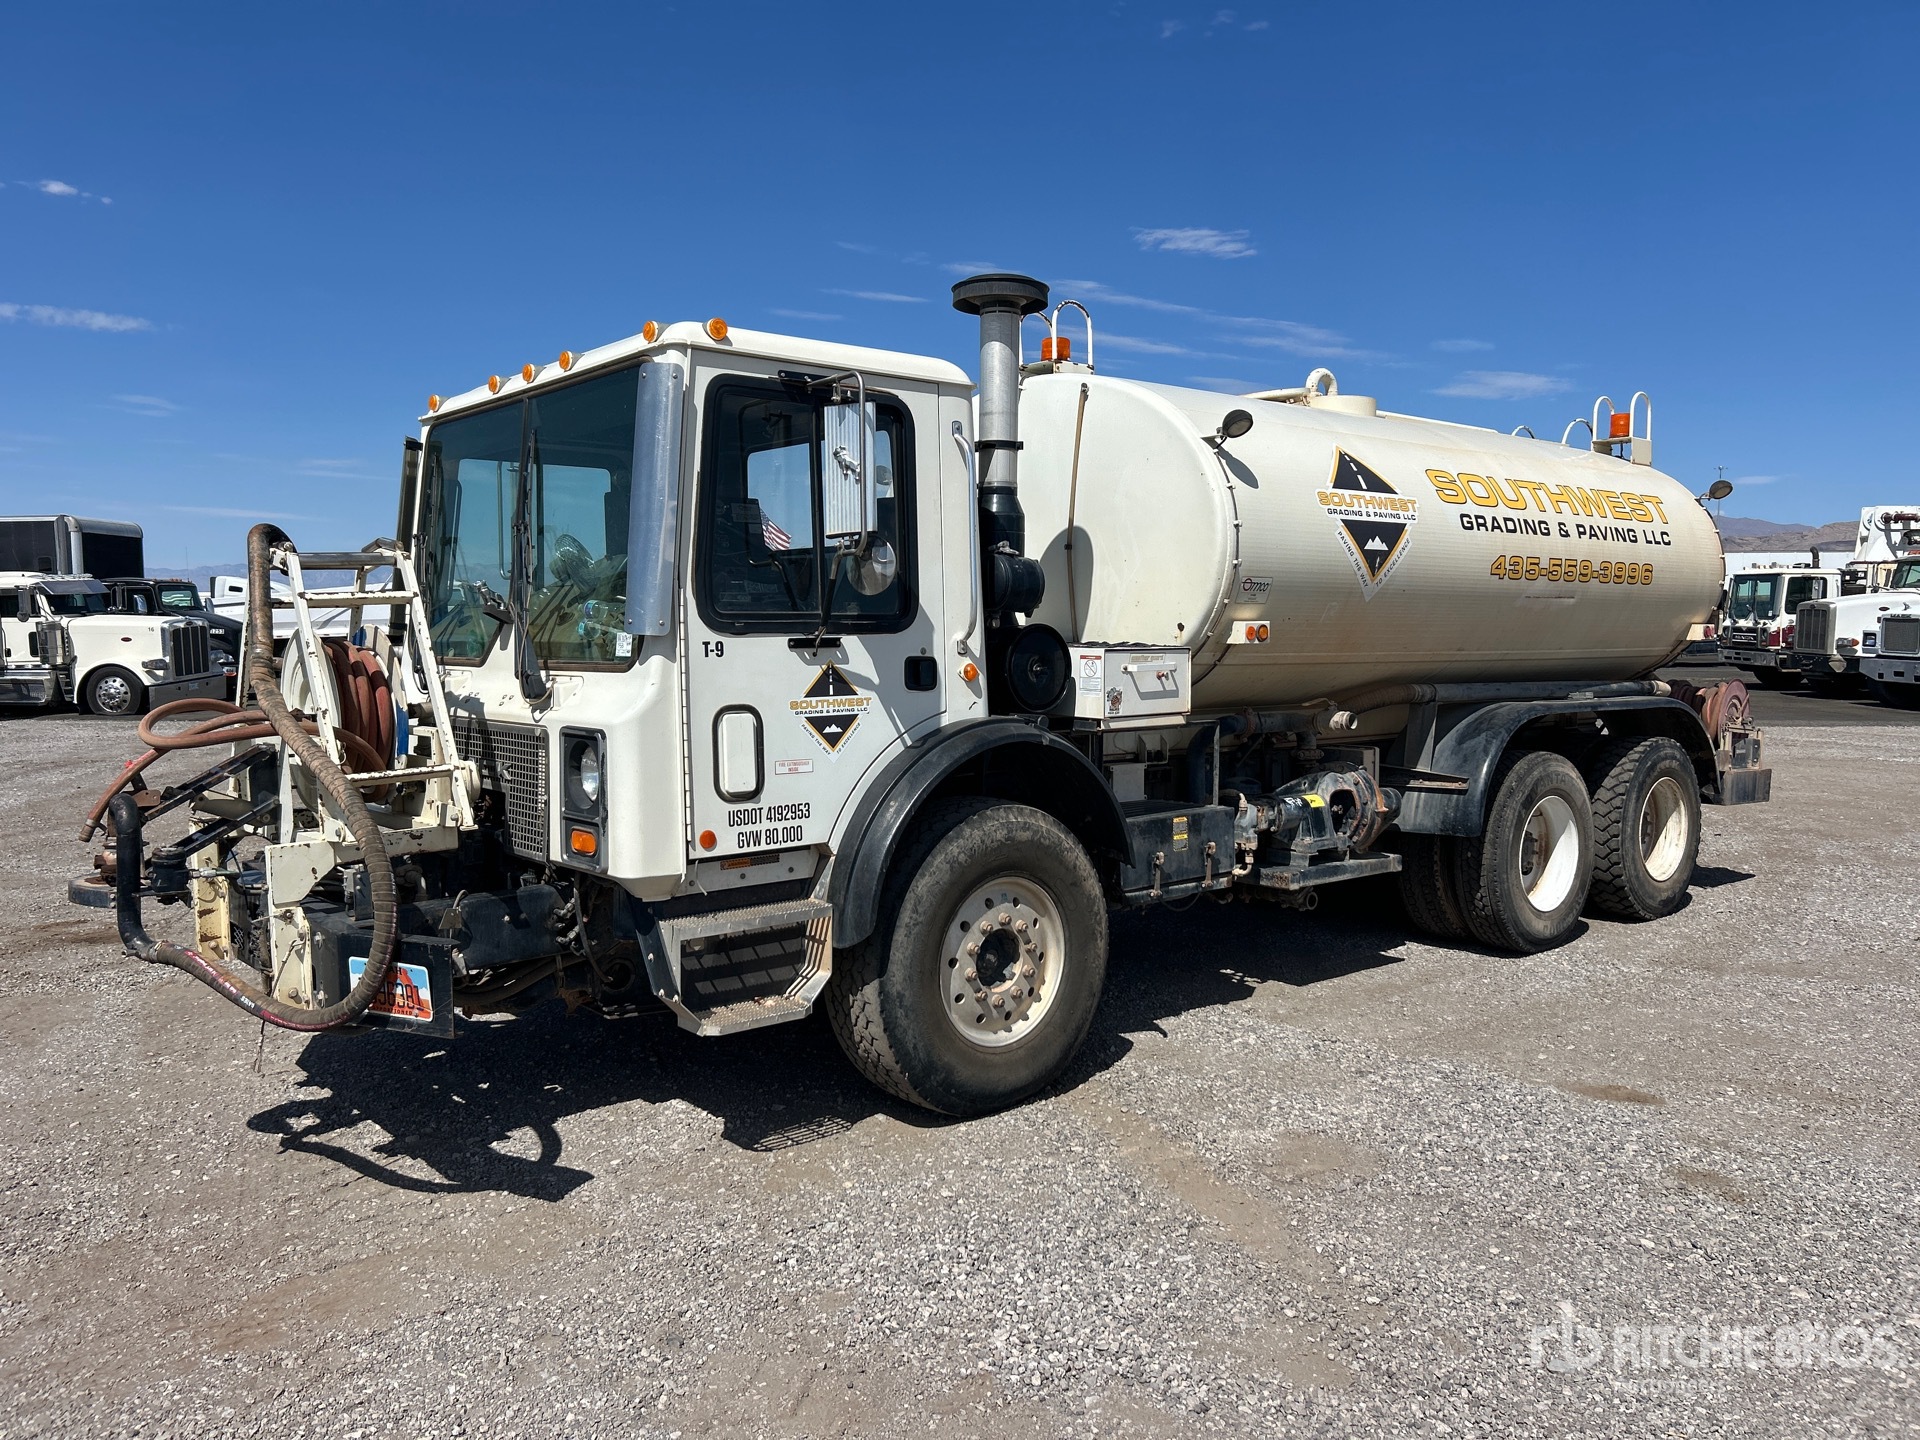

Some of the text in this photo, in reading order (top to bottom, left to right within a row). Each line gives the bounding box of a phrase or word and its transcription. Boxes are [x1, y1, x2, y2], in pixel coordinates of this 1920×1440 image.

[1317, 491, 1417, 513] SOUTHWEST
[1425, 469, 1669, 525] SOUTHWEST
[1327, 508, 1363, 517] GRADING
[1374, 512, 1400, 520] PAVING
[1403, 513, 1417, 521] LLC
[1460, 513, 1672, 546] GRADING & PAVING LLC
[1337, 531, 1369, 588] PAVING THE WAY
[1382, 537, 1411, 578] EXCELLENCE
[1490, 554, 1654, 585] 435-559-3996
[702, 641, 724, 658] T-9
[789, 697, 872, 710] SOUTHWEST
[727, 802, 811, 827] USDOT 4192953
[737, 825, 803, 849] GVW 80,000
